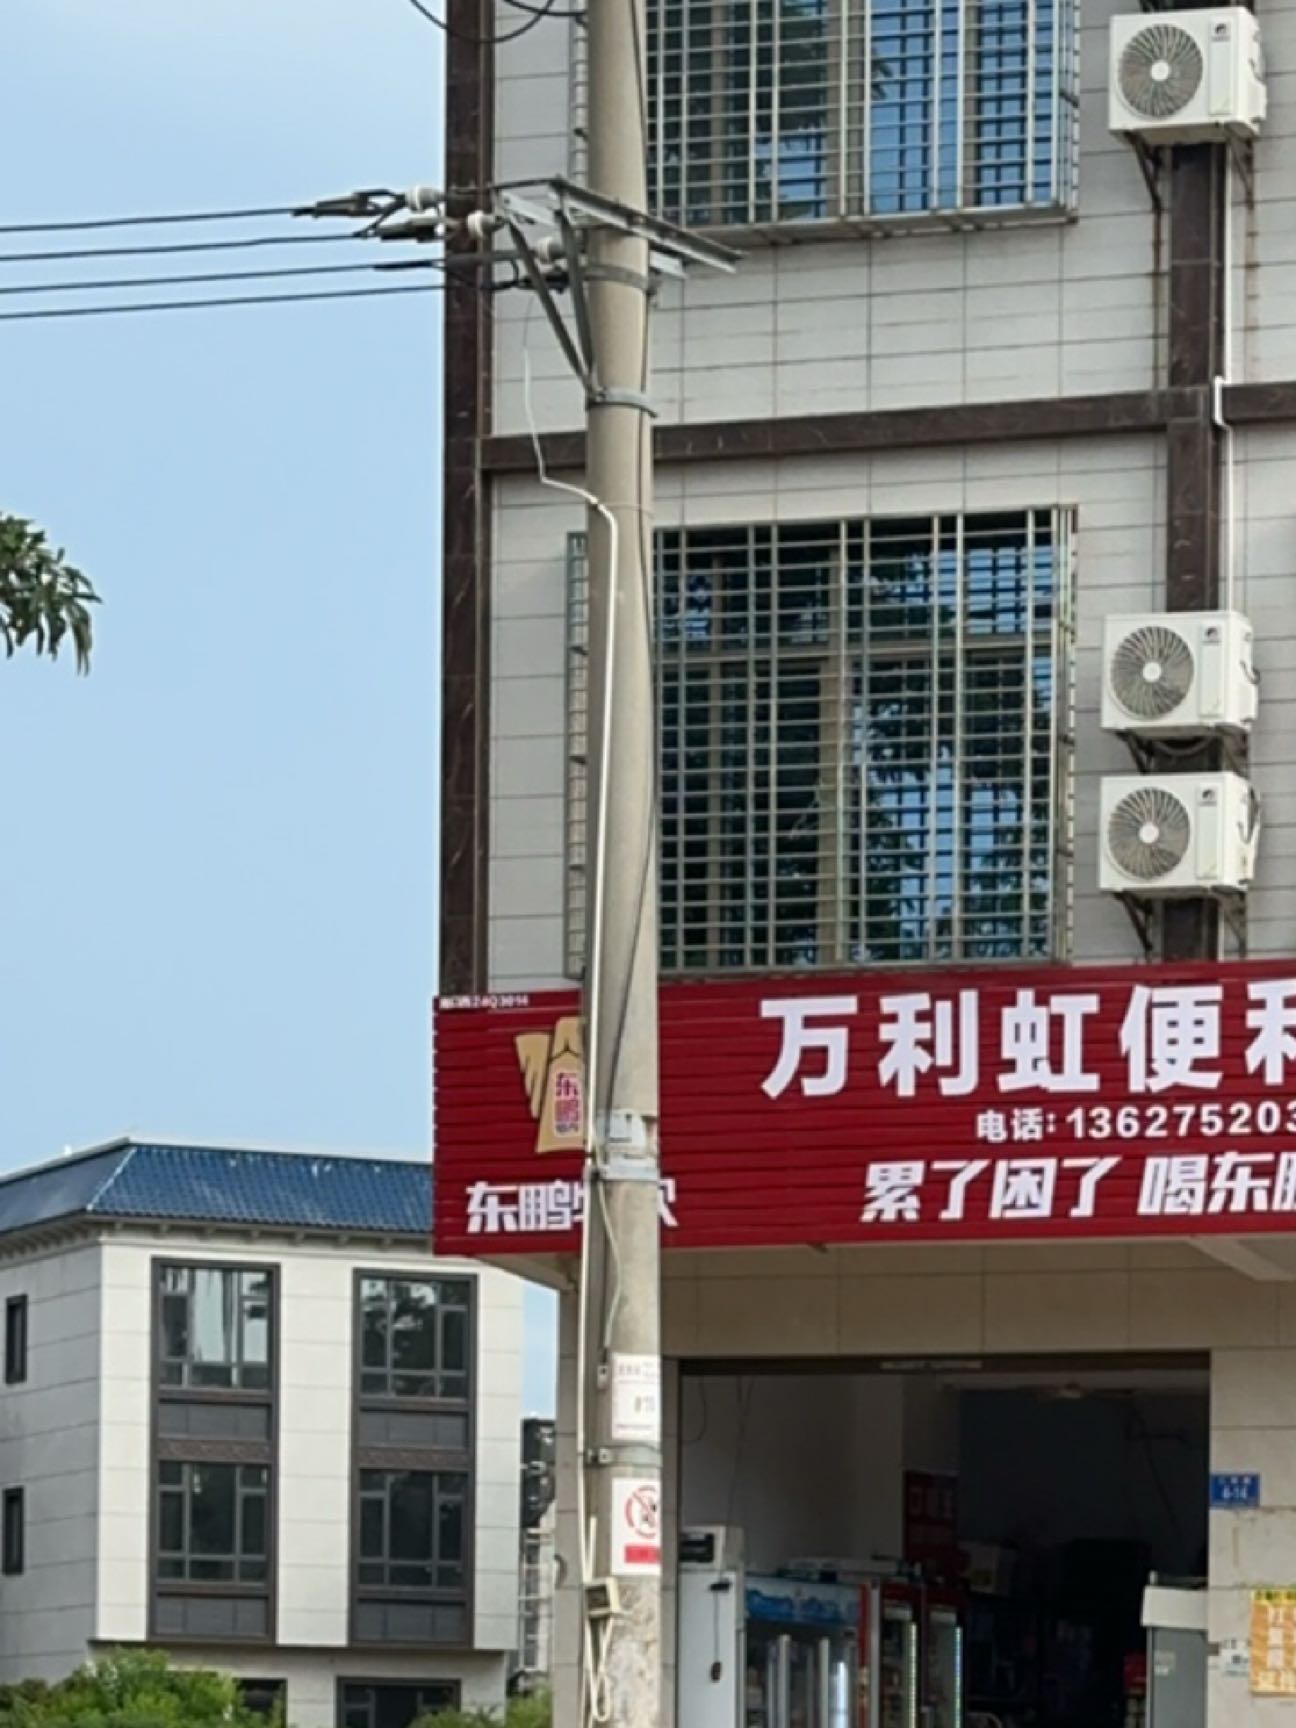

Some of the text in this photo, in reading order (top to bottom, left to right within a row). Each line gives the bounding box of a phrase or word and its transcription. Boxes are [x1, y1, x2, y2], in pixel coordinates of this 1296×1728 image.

[465, 1178, 679, 1234] 东鹏
[860, 1155, 1122, 1223] 累了困了
